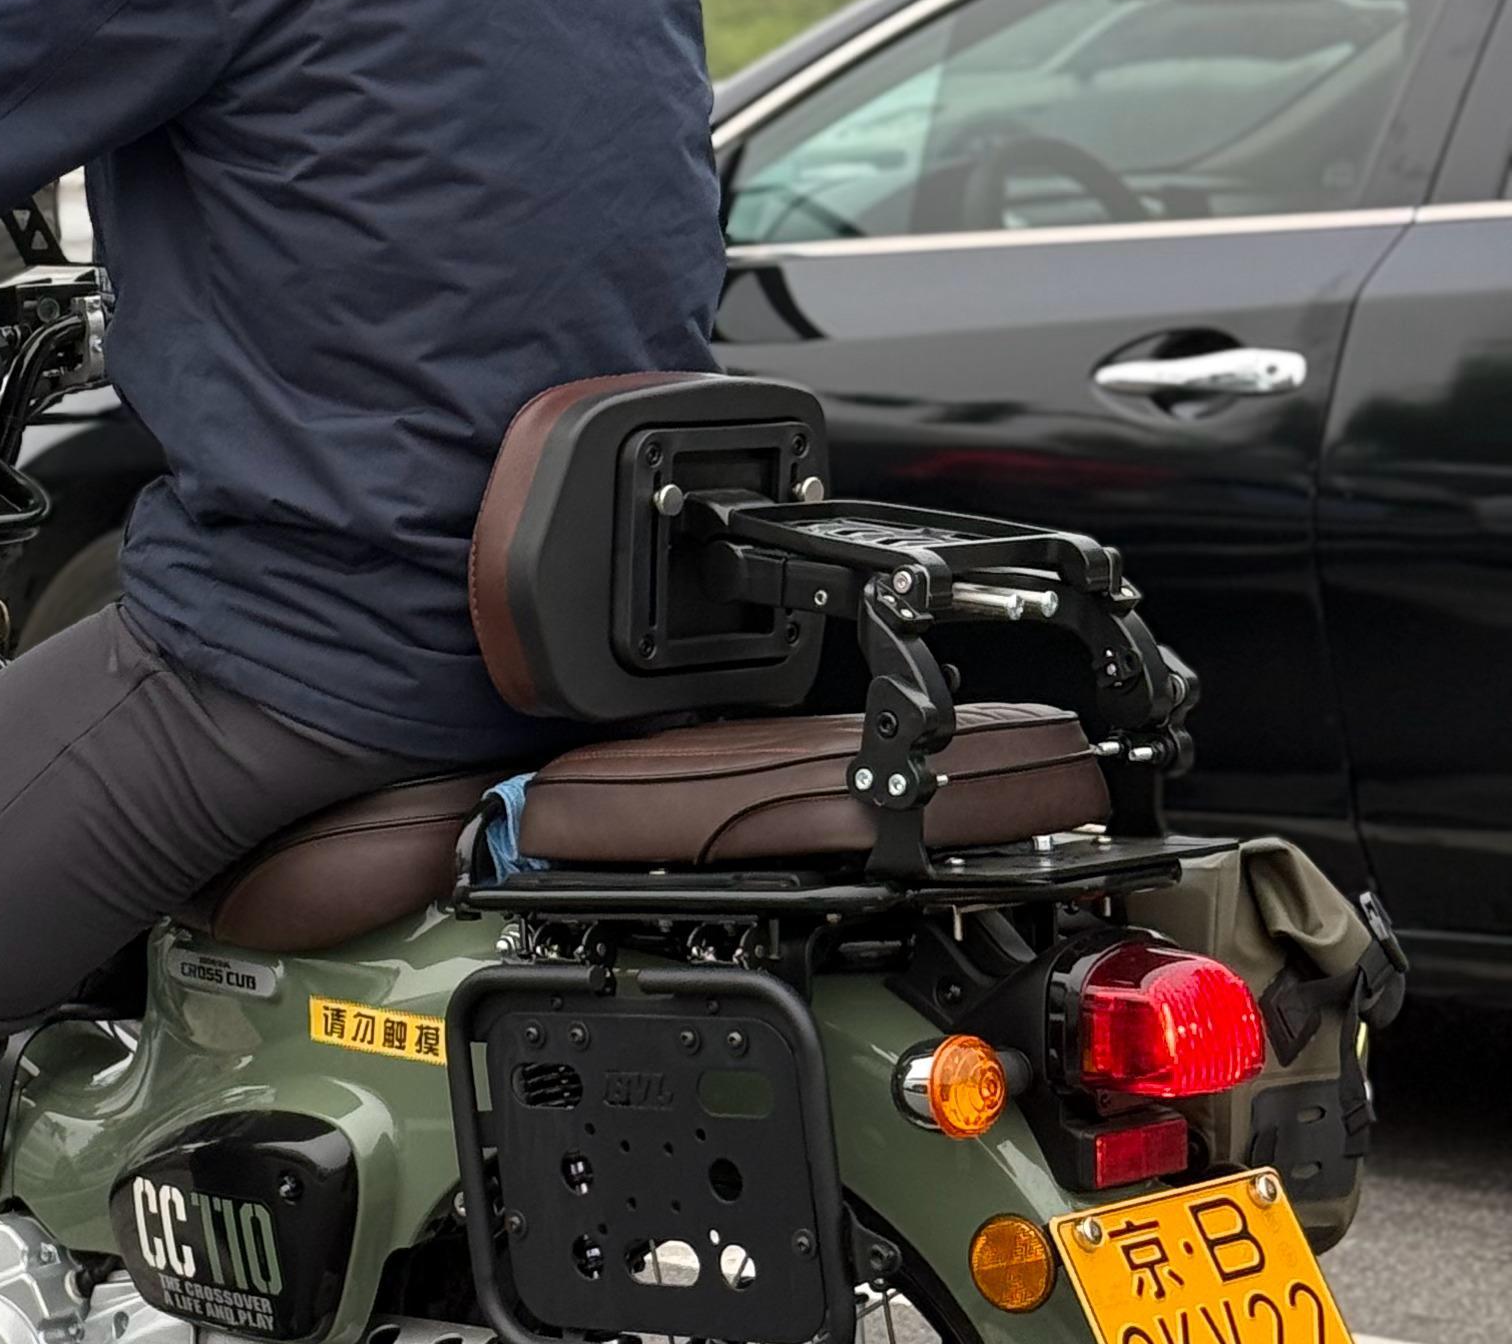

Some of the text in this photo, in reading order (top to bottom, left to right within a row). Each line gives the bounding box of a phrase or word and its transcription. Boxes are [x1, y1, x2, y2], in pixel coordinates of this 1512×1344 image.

[180, 961, 256, 990] CROSS CUB
[323, 1005, 441, 1057] 请勿触摸
[159, 1273, 273, 1314] THE CROSSOVER
[164, 1290, 174, 1306] A
[175, 1294, 204, 1315] LIFE
